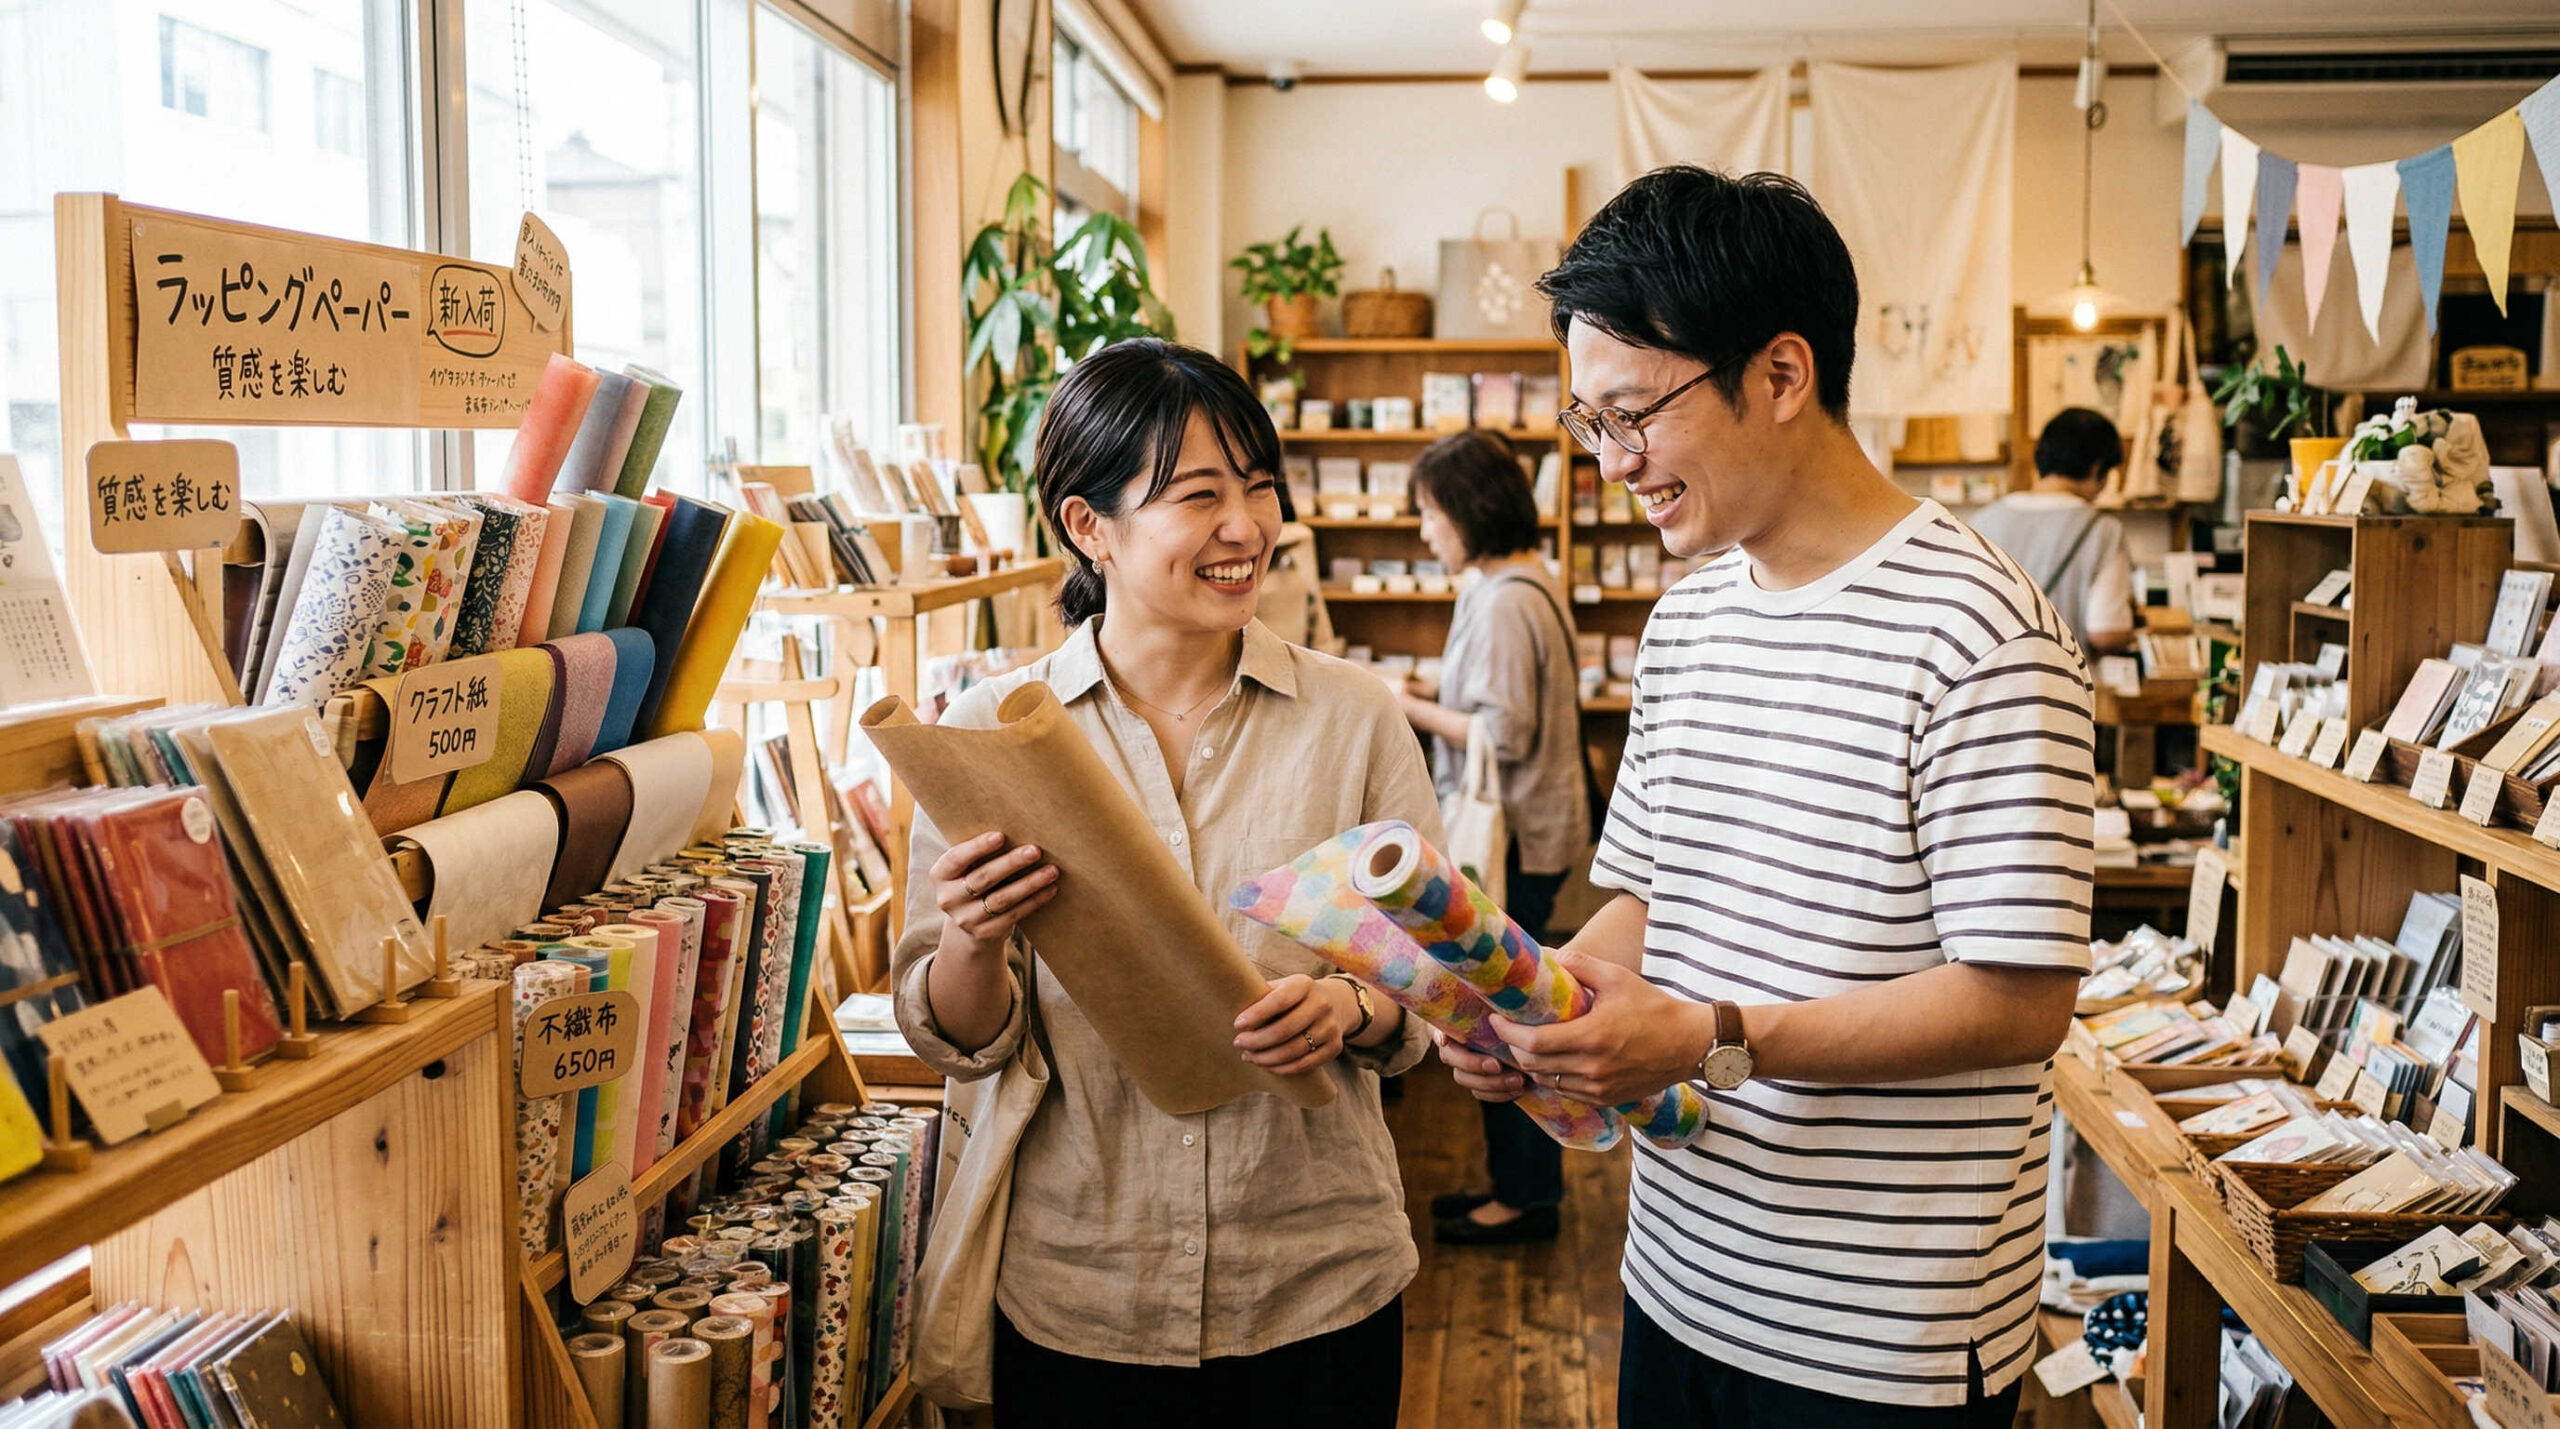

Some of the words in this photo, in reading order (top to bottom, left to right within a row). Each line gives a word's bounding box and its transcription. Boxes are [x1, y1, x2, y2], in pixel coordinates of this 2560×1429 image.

[157, 254, 410, 333] ラッピングペーパー
[440, 280, 495, 333] 新入荷
[212, 345, 348, 401] 質感を楽しむ
[97, 472, 231, 527] 質感を楽しむ
[410, 676, 488, 724] クラフト紙
[429, 727, 477, 759] 500円
[537, 1002, 618, 1046] 不織布
[553, 1048, 616, 1081] 650円
